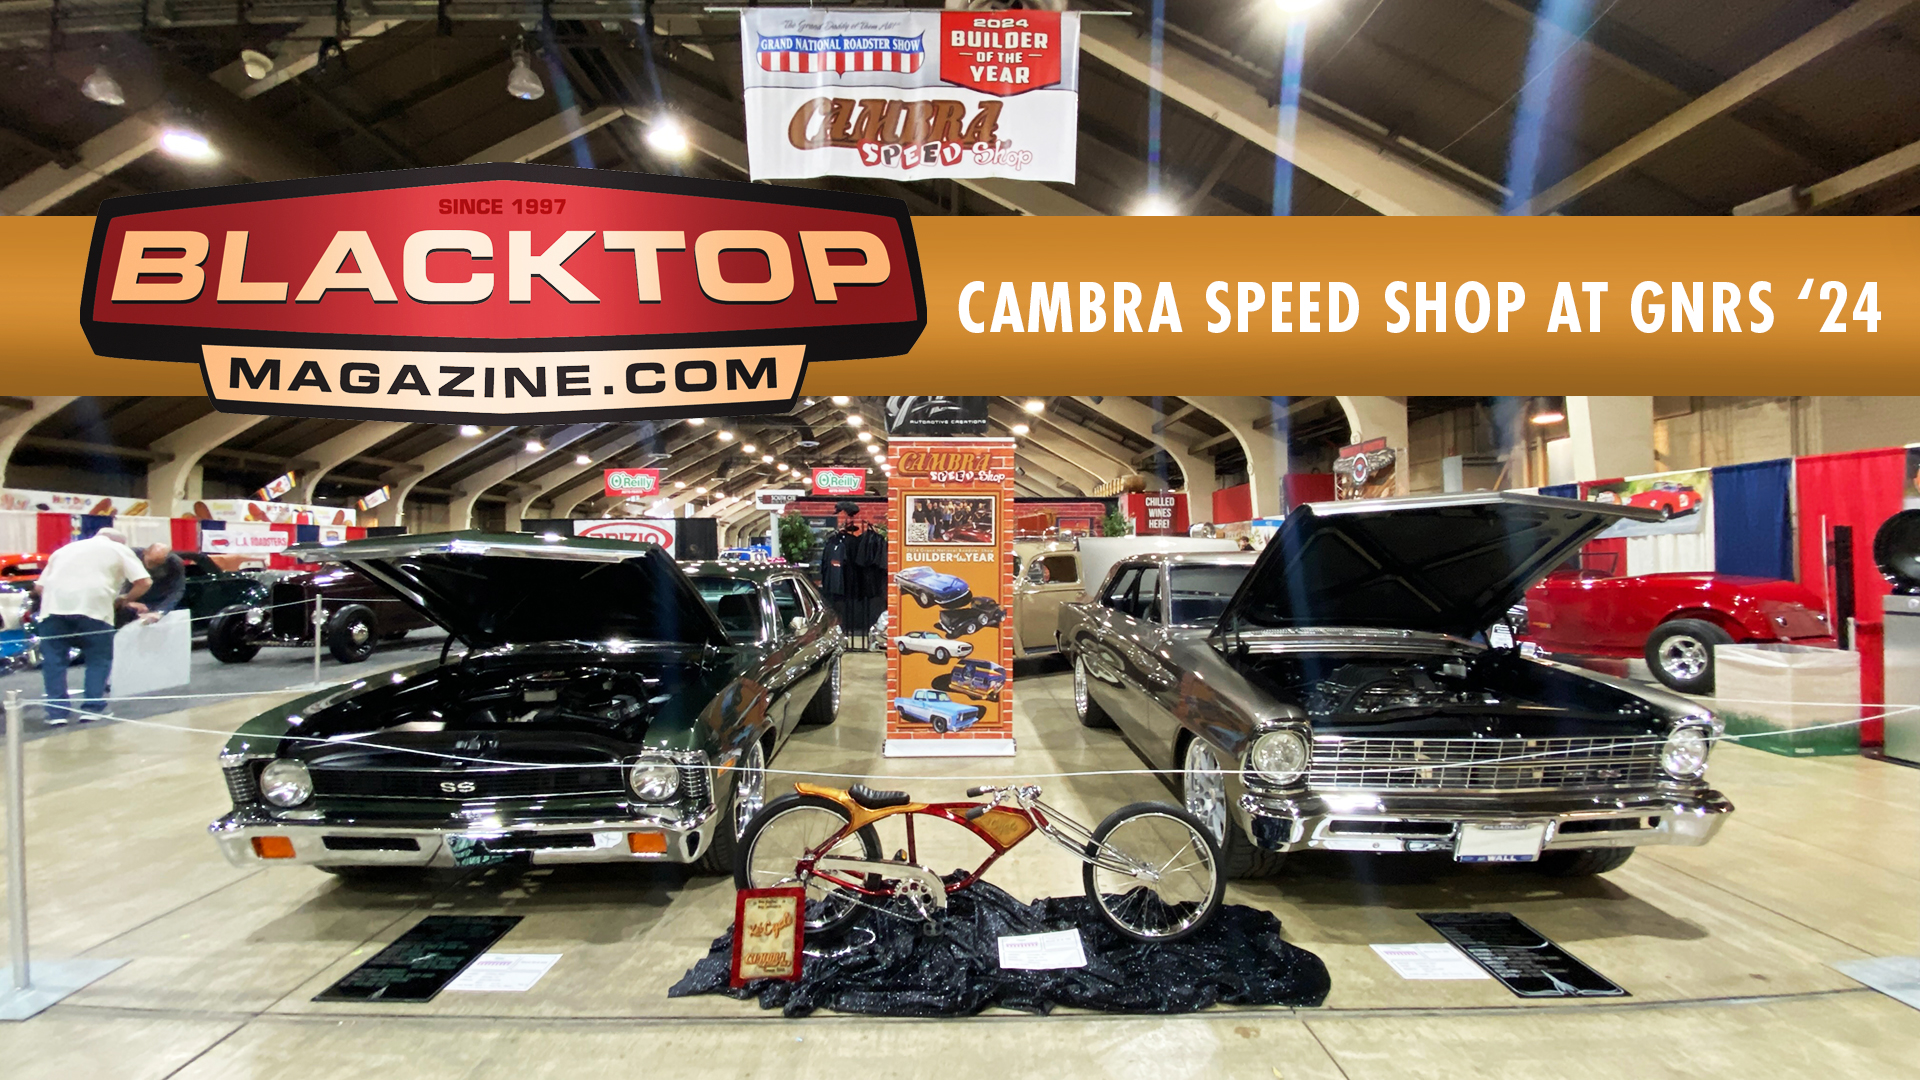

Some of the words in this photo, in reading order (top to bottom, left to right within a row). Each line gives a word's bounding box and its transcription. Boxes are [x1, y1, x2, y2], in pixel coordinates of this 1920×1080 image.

[797, 20, 822, 32] Grand
[824, 21, 848, 32] Daddy
[850, 22, 859, 30] of
[860, 21, 878, 30] Them
[973, 18, 1029, 28] 2024
[761, 38, 793, 50] GRAND
[795, 38, 841, 51] NATIONAL
[844, 38, 890, 50] ROADSTER
[892, 38, 921, 51] SHOW
[951, 30, 1048, 49] BUILDER
[976, 52, 995, 63] OF
[998, 52, 1023, 63] THE
[969, 65, 1030, 84] YEAR
[788, 97, 1011, 150] CAMBRA
[857, 139, 963, 169] SPEED
[973, 139, 1033, 171] Shop
[898, 451, 992, 477] CAMBRA
[610, 473, 654, 489] O'Reilly
[818, 473, 859, 488] O'Reilly
[929, 471, 974, 482] SPEED
[977, 470, 1006, 484] Shop
[1145, 497, 1175, 506] CHILLED
[1148, 508, 1172, 518] WINES
[1148, 519, 1170, 528] HERE!
[250, 537, 287, 547] ROADSTERS
[906, 552, 953, 562] BUILDER
[965, 552, 995, 562] YEAR
[440, 781, 476, 793] SS
